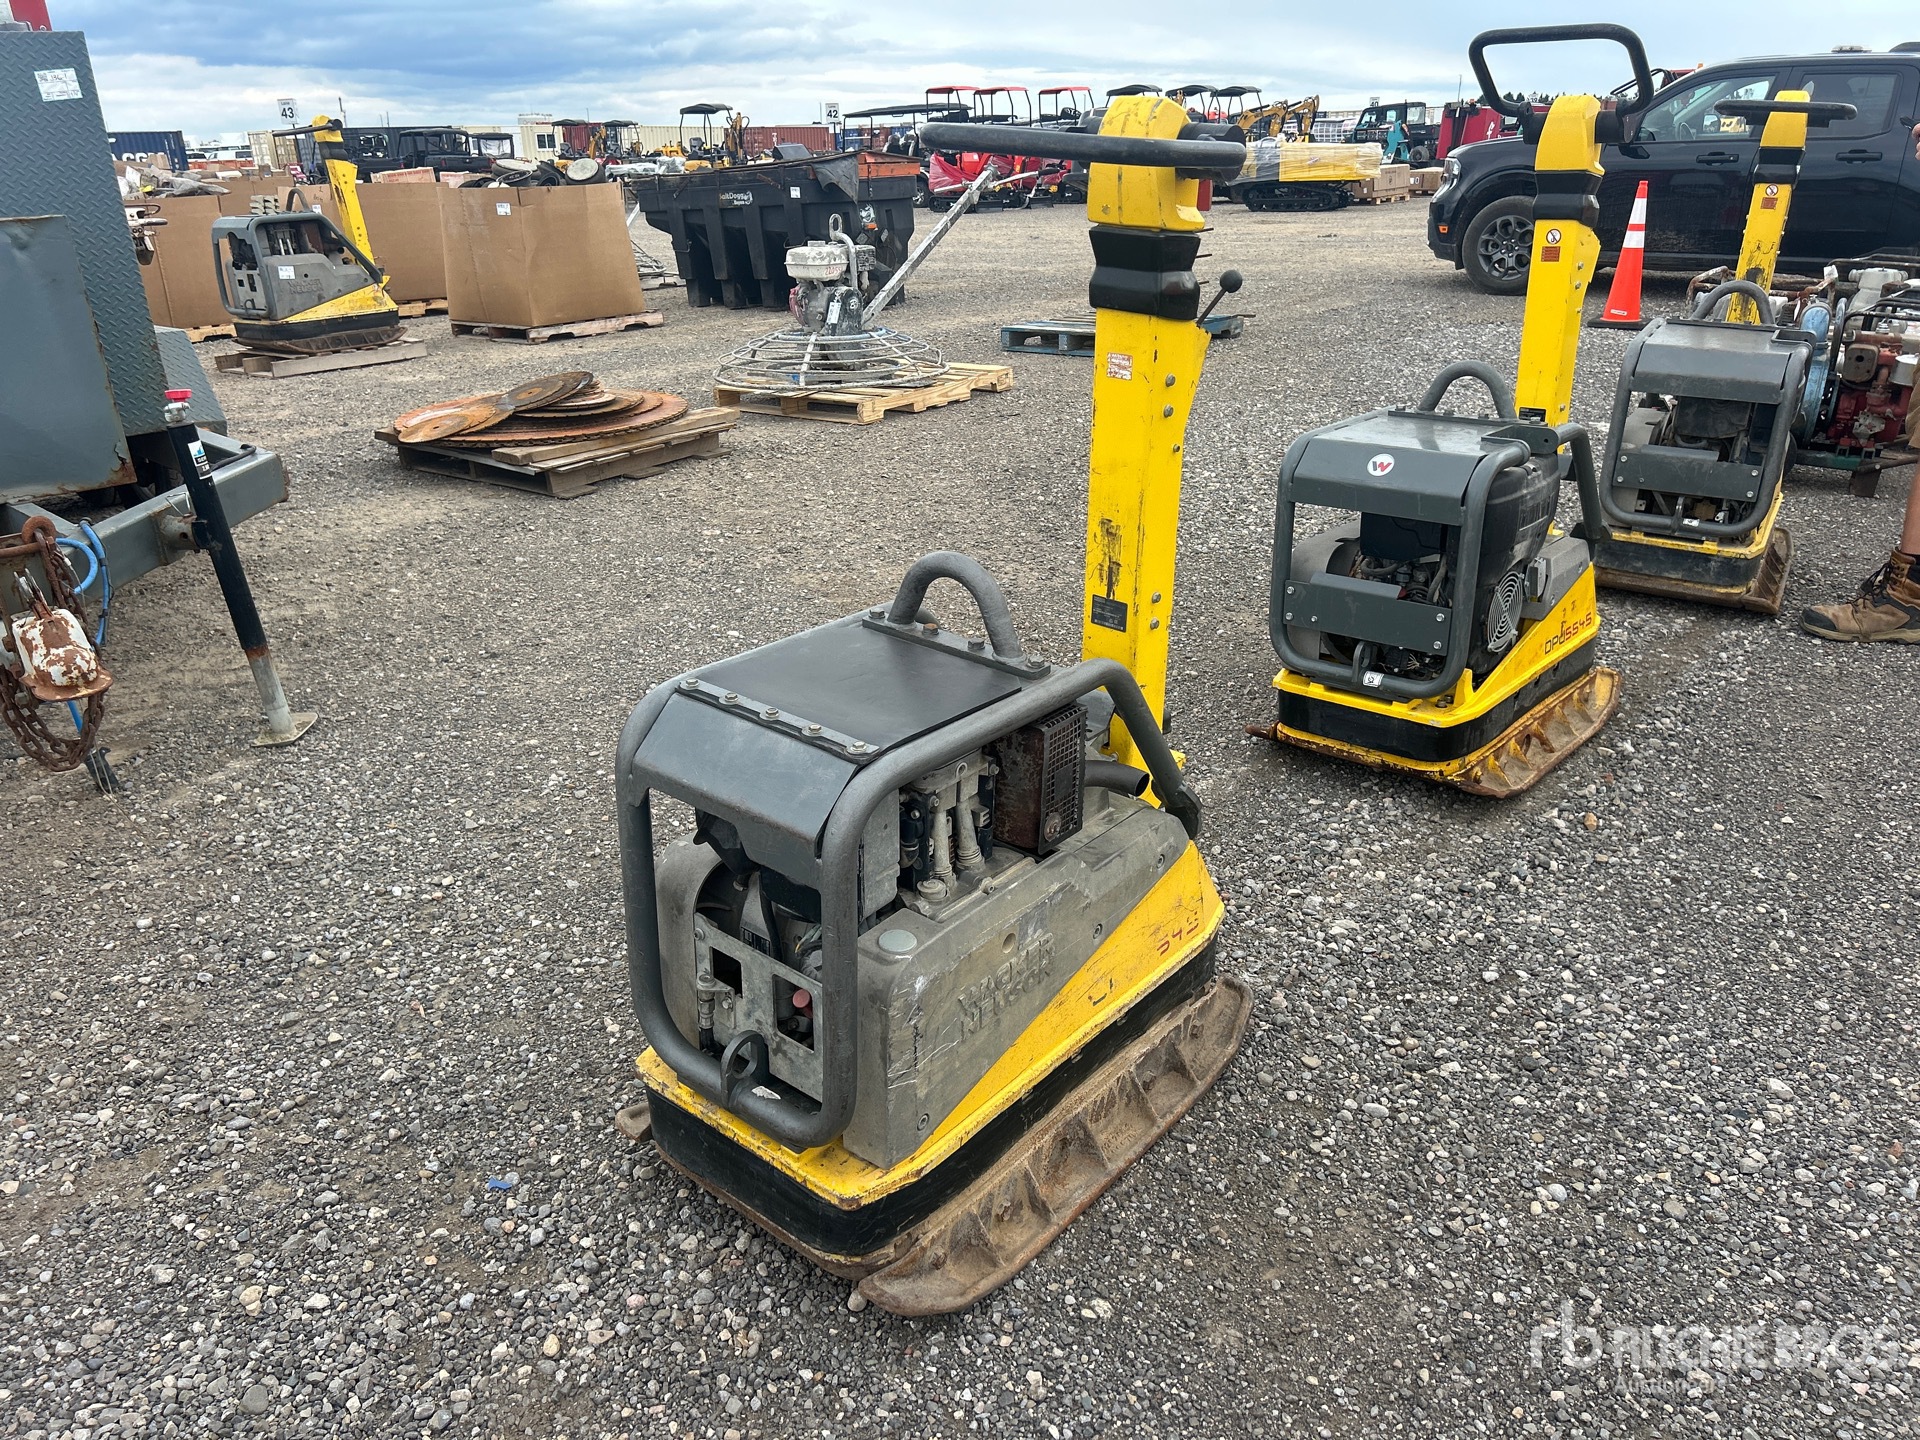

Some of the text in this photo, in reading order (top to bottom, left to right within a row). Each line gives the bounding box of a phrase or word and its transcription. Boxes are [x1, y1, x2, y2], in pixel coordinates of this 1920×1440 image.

[281, 107, 294, 119] 43
[827, 109, 838, 118] 42
[957, 932, 1055, 1017] WACKER
[960, 956, 1053, 1042] NEUSON
